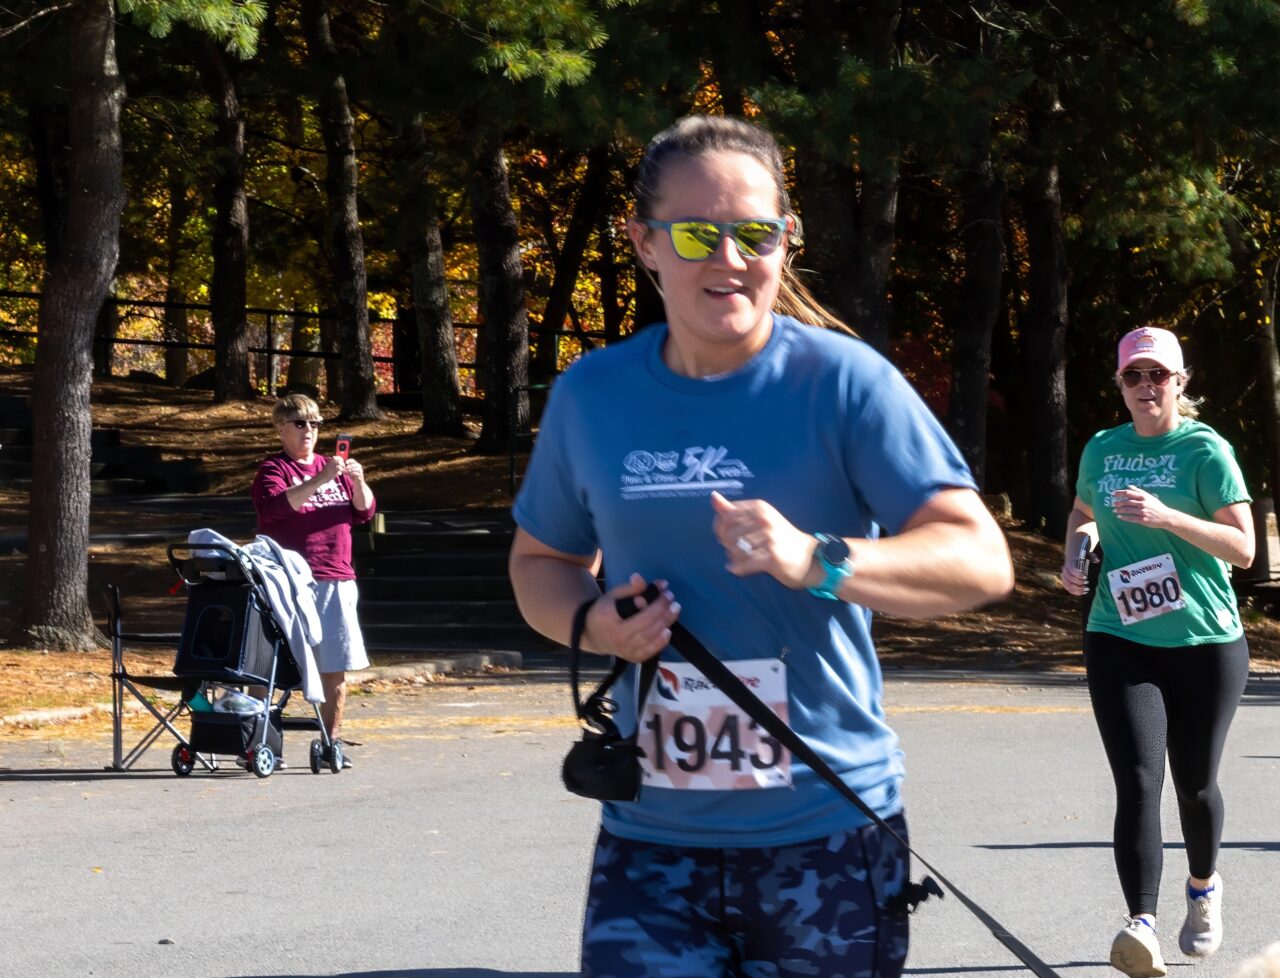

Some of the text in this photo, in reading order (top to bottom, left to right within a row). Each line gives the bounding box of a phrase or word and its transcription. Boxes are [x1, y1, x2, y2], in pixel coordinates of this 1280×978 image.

[678, 445, 728, 482] 5K
[1117, 577, 1180, 617] 1980
[645, 713, 782, 772] 1943
